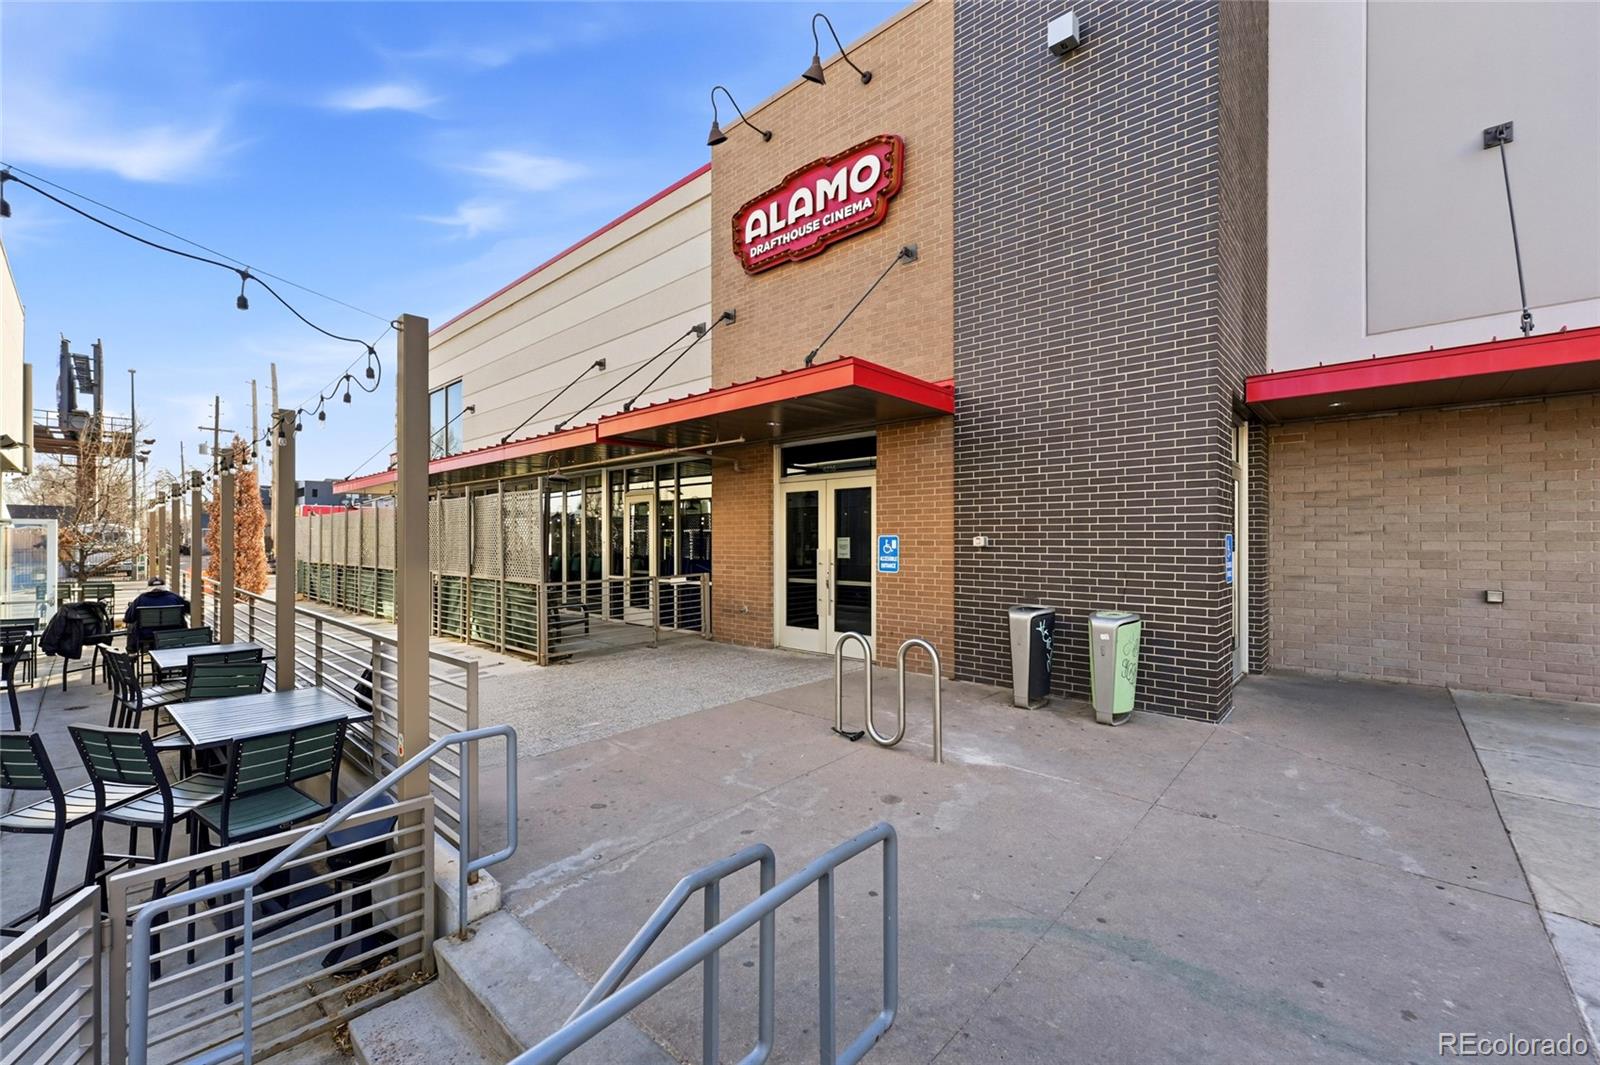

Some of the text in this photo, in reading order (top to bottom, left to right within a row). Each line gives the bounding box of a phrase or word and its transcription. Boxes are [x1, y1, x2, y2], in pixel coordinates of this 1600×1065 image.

[745, 154, 881, 244] ALAMO
[750, 197, 872, 258] DRAFTHOUSE CINEMA
